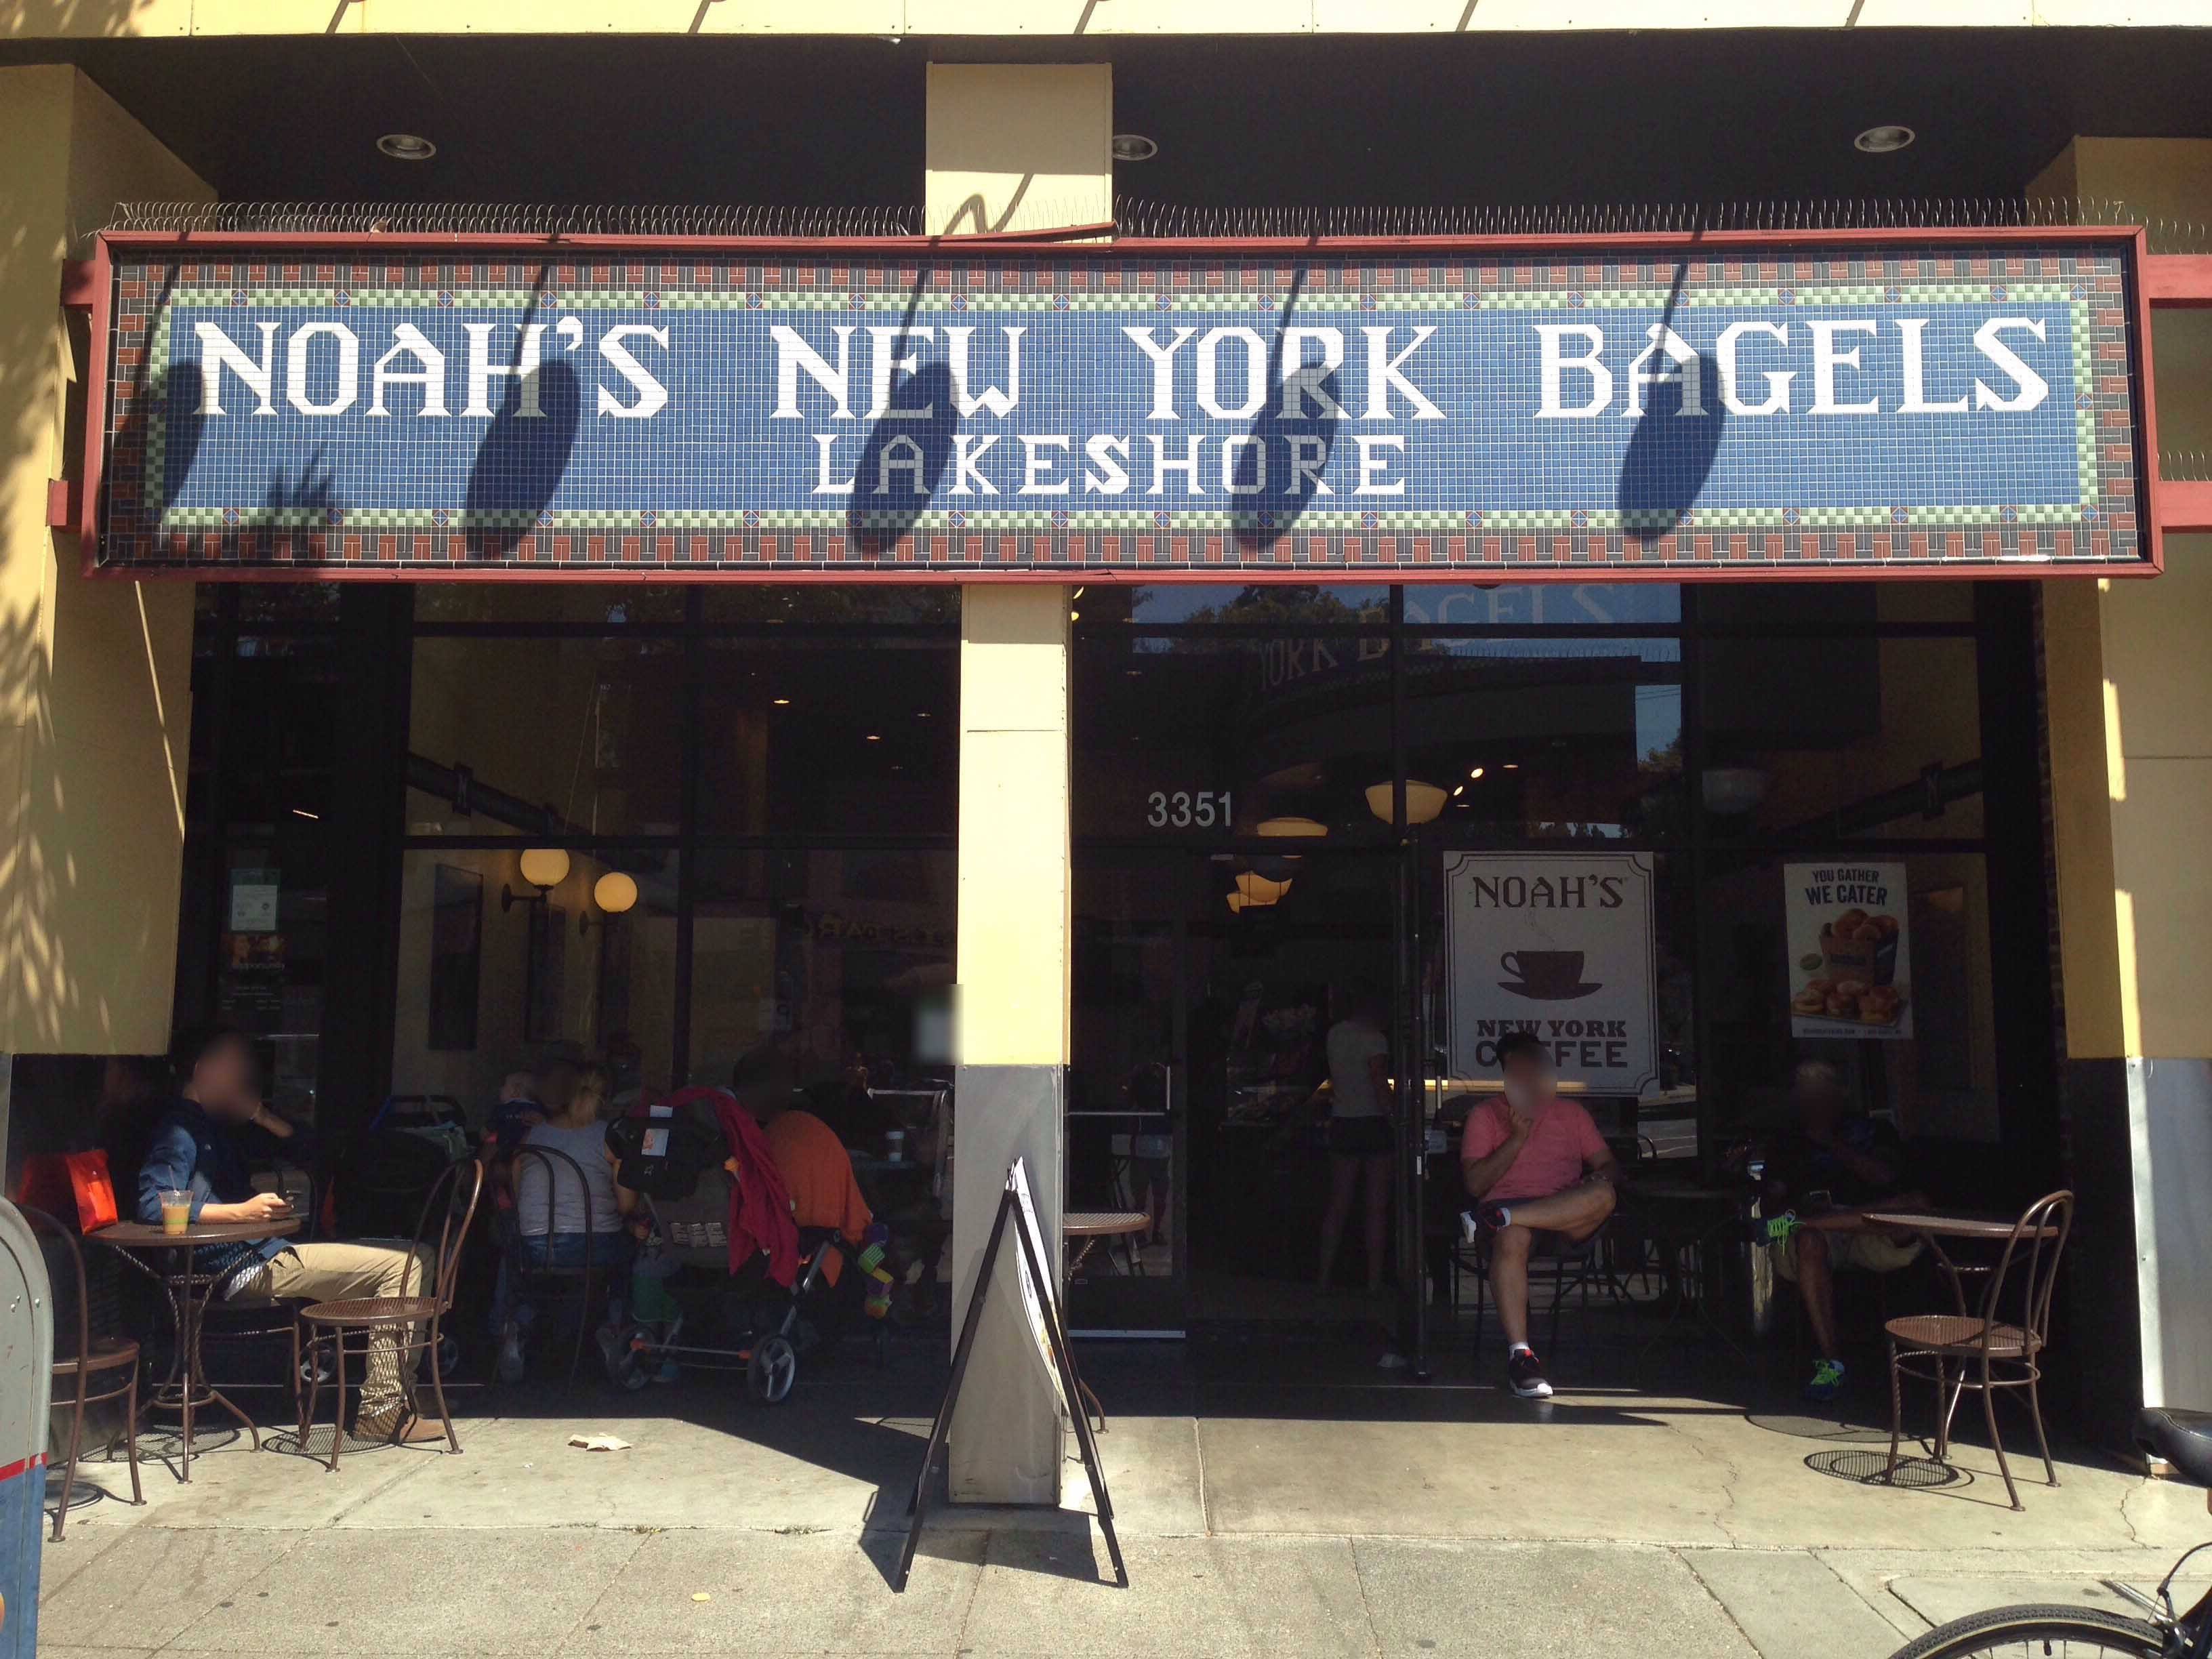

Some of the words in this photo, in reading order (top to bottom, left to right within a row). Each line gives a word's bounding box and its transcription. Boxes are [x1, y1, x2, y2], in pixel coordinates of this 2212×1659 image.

[192, 316, 669, 417] NOAH'S
[770, 325, 1027, 419] NEW
[1121, 325, 1447, 419] YORK
[1532, 317, 2049, 418] BAGELS
[812, 434, 1406, 495] LAKESHORE
[1147, 791, 1231, 827] 3351
[1473, 874, 1624, 908] NOAH'S
[1812, 869, 1835, 883] YOU
[1837, 868, 1879, 883] GATHER
[1805, 886, 1833, 905] WE
[1837, 884, 1887, 906] CATER
[1477, 1019, 1542, 1038] NEW
[1547, 1019, 1627, 1038] YORK
[1475, 1040, 1629, 1068] CFEE
